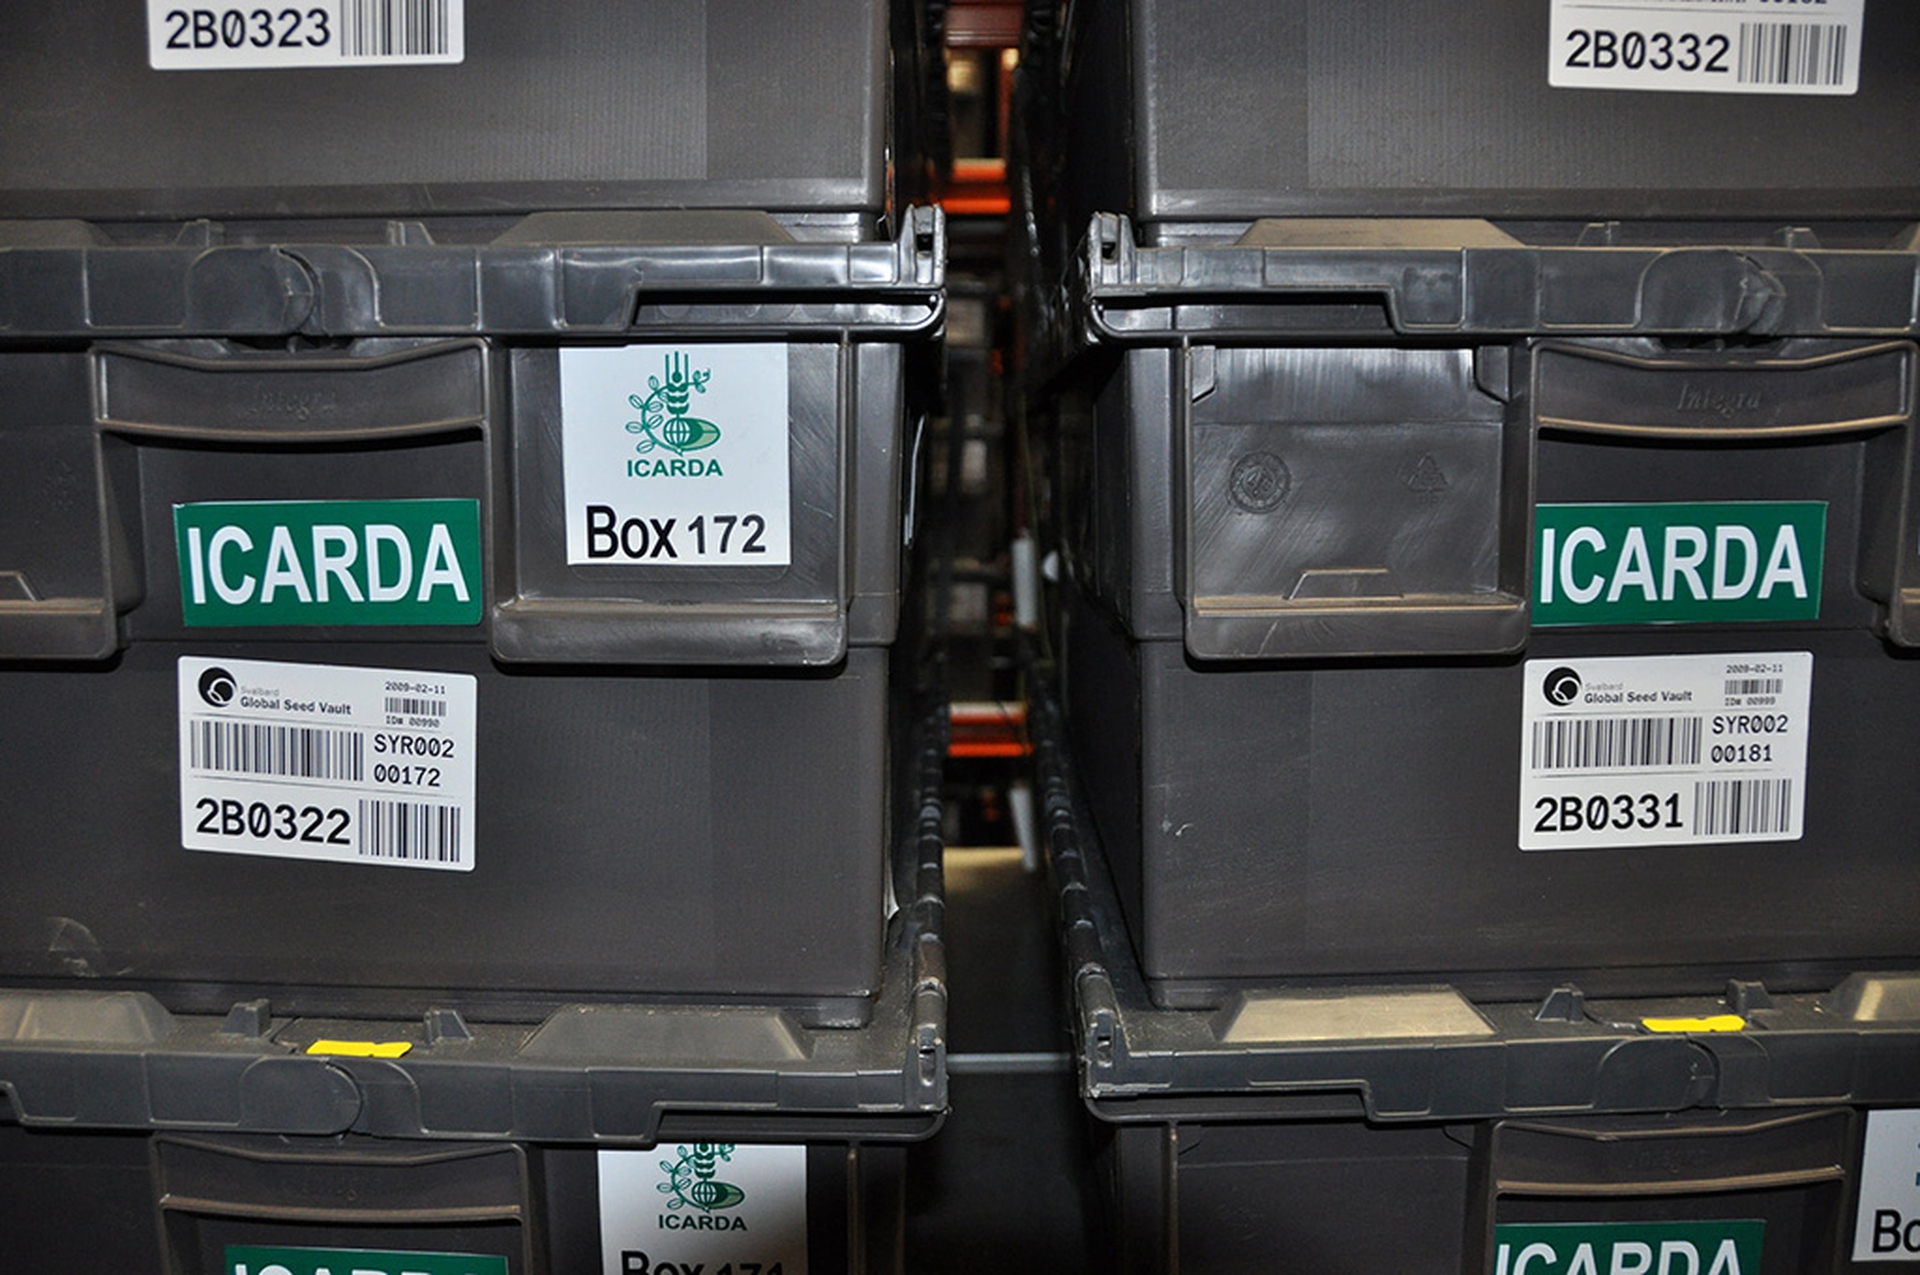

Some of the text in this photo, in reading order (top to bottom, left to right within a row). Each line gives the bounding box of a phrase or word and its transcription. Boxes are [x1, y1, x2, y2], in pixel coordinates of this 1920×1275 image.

[165, 9, 331, 49] 2B0323
[1565, 29, 1730, 73] 2B0332
[627, 459, 724, 477] ICARDA
[586, 504, 766, 559] Box 172
[187, 523, 471, 605] ICARDA
[1540, 524, 1808, 604] ICARDA
[1725, 663, 1783, 674] 2009-02-11
[384, 680, 446, 695] 2009-02-11
[1583, 690, 1693, 704] Global Seed Vault
[240, 695, 352, 715] Global Seed Vault
[1712, 714, 1789, 735] SYR002
[373, 733, 455, 760] SYR002
[1710, 743, 1773, 764] 00181
[373, 764, 441, 788] 00172
[195, 797, 352, 846] 2B0322
[1533, 792, 1684, 833] 2B0331
[658, 1213, 748, 1231] ICARDA
